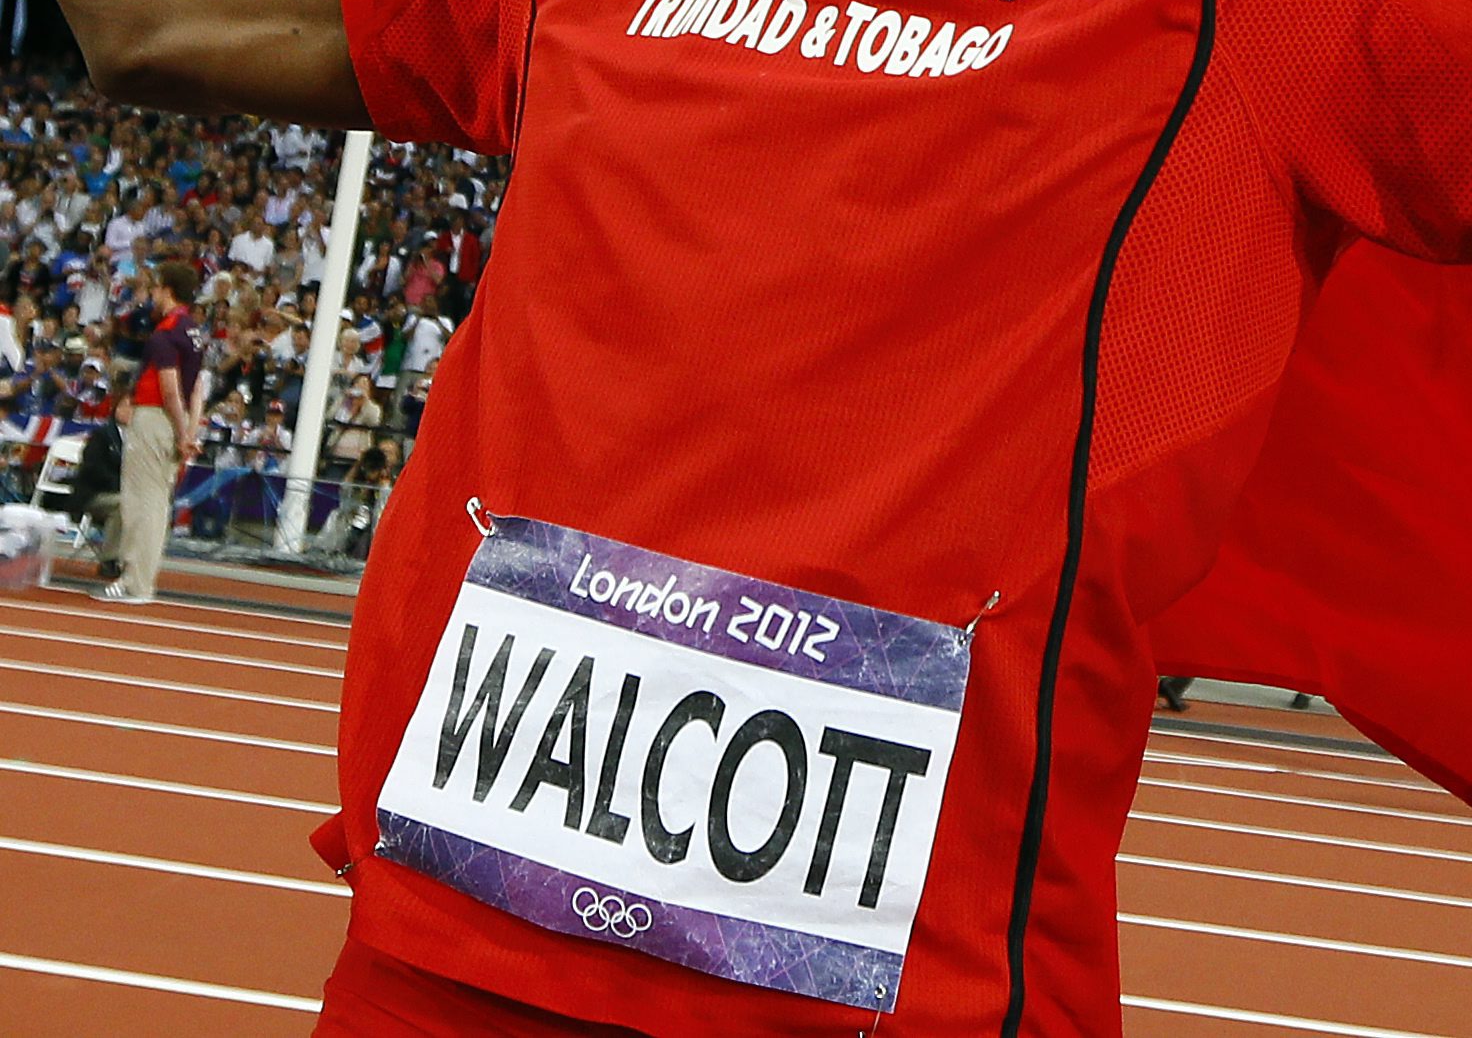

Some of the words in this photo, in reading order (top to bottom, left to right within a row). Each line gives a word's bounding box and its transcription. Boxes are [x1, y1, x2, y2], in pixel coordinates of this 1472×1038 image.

[800, 5, 838, 58] &
[834, 1, 1013, 77] TOBAGO
[569, 553, 720, 633] London
[727, 597, 840, 662] 2012
[432, 624, 932, 910] WALCOTT
